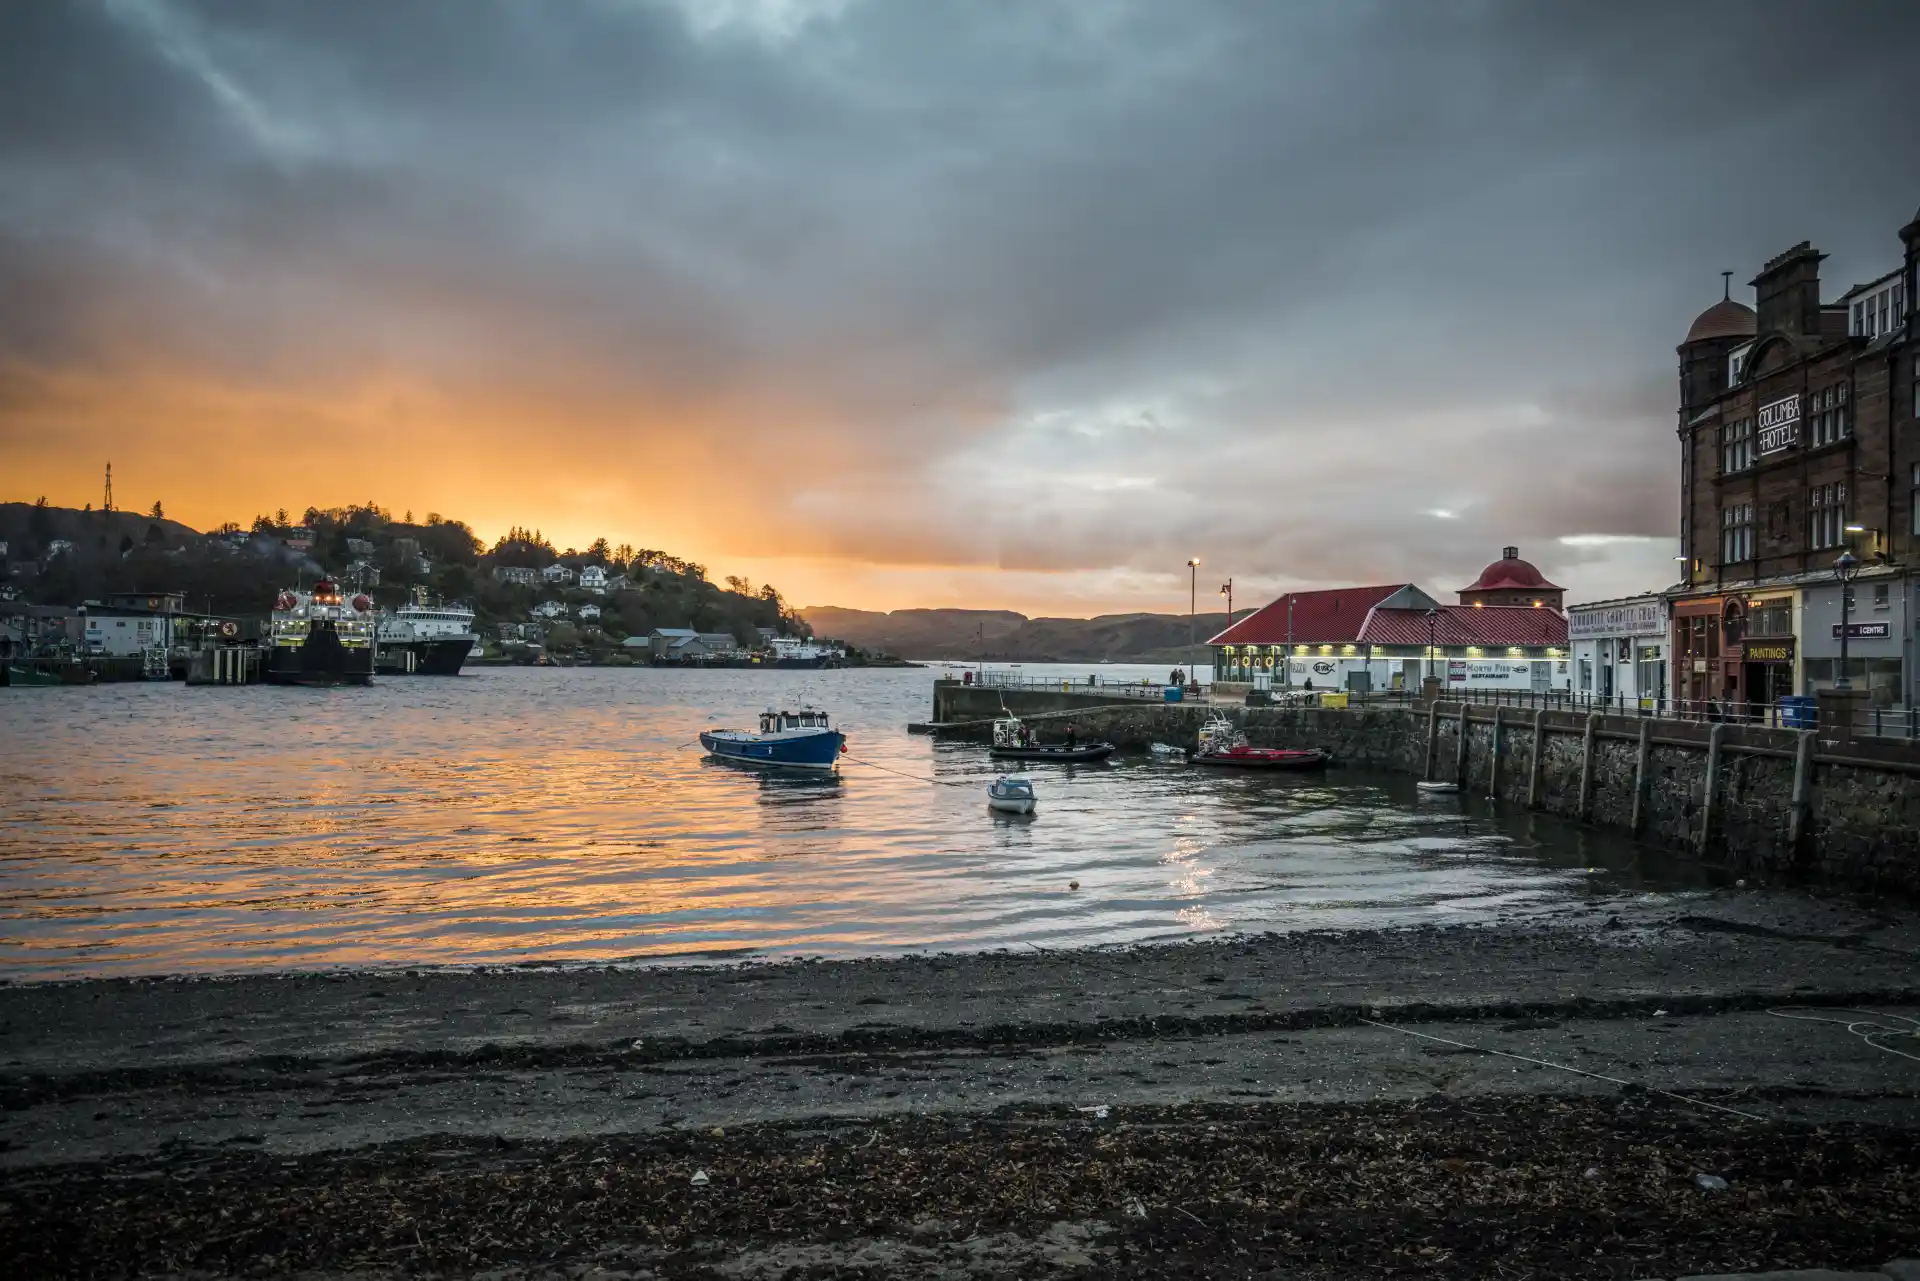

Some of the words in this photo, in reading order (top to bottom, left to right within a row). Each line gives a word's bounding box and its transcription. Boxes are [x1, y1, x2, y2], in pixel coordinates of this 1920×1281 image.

[1759, 398, 1800, 428] COLUMBA
[1762, 425, 1796, 451] HOTEL
[1749, 647, 1787, 659] PAINTINGS
